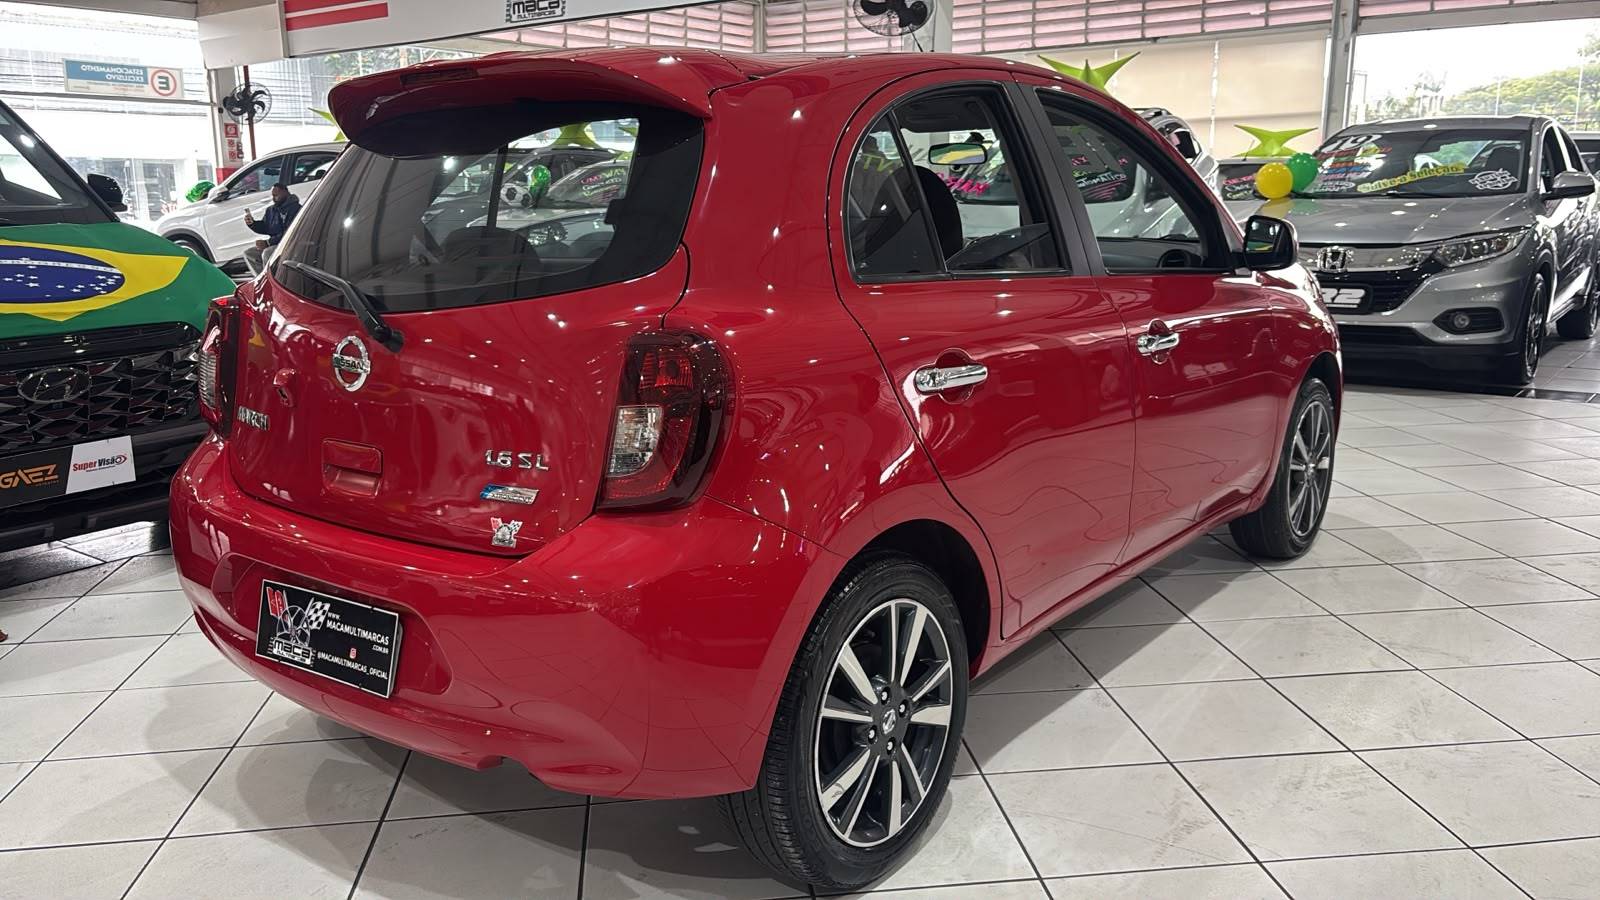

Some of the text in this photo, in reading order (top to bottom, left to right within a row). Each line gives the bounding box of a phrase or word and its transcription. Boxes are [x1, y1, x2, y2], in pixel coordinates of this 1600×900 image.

[73, 460, 97, 471] Super
[326, 619, 389, 646] MACAMULTIMARCAS
[317, 650, 388, 680] @MACAMULTIMARCAS_OFICIAL
